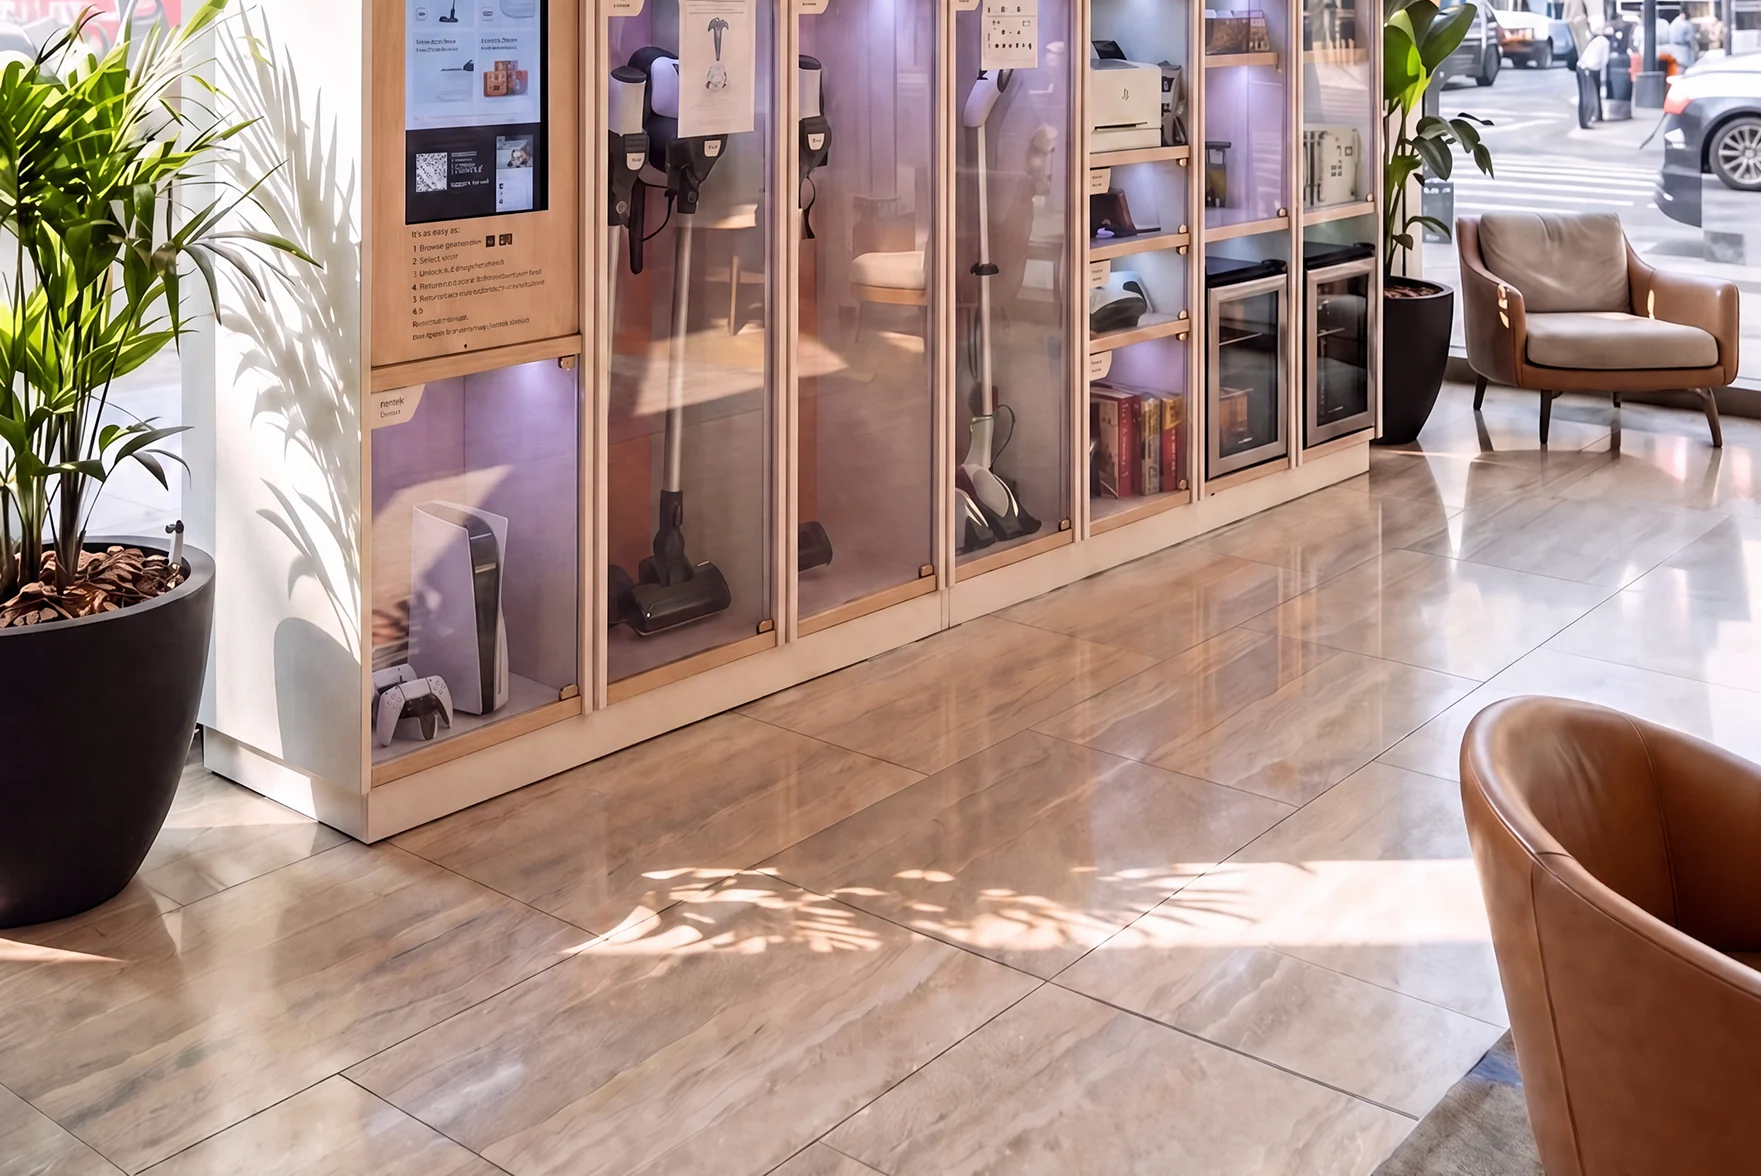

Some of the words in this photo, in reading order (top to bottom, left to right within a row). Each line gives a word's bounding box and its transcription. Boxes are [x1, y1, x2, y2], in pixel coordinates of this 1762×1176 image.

[411, 230, 422, 238] It's
[419, 243, 444, 252] Browse
[419, 256, 441, 264] Select
[419, 269, 443, 277] Unlock
